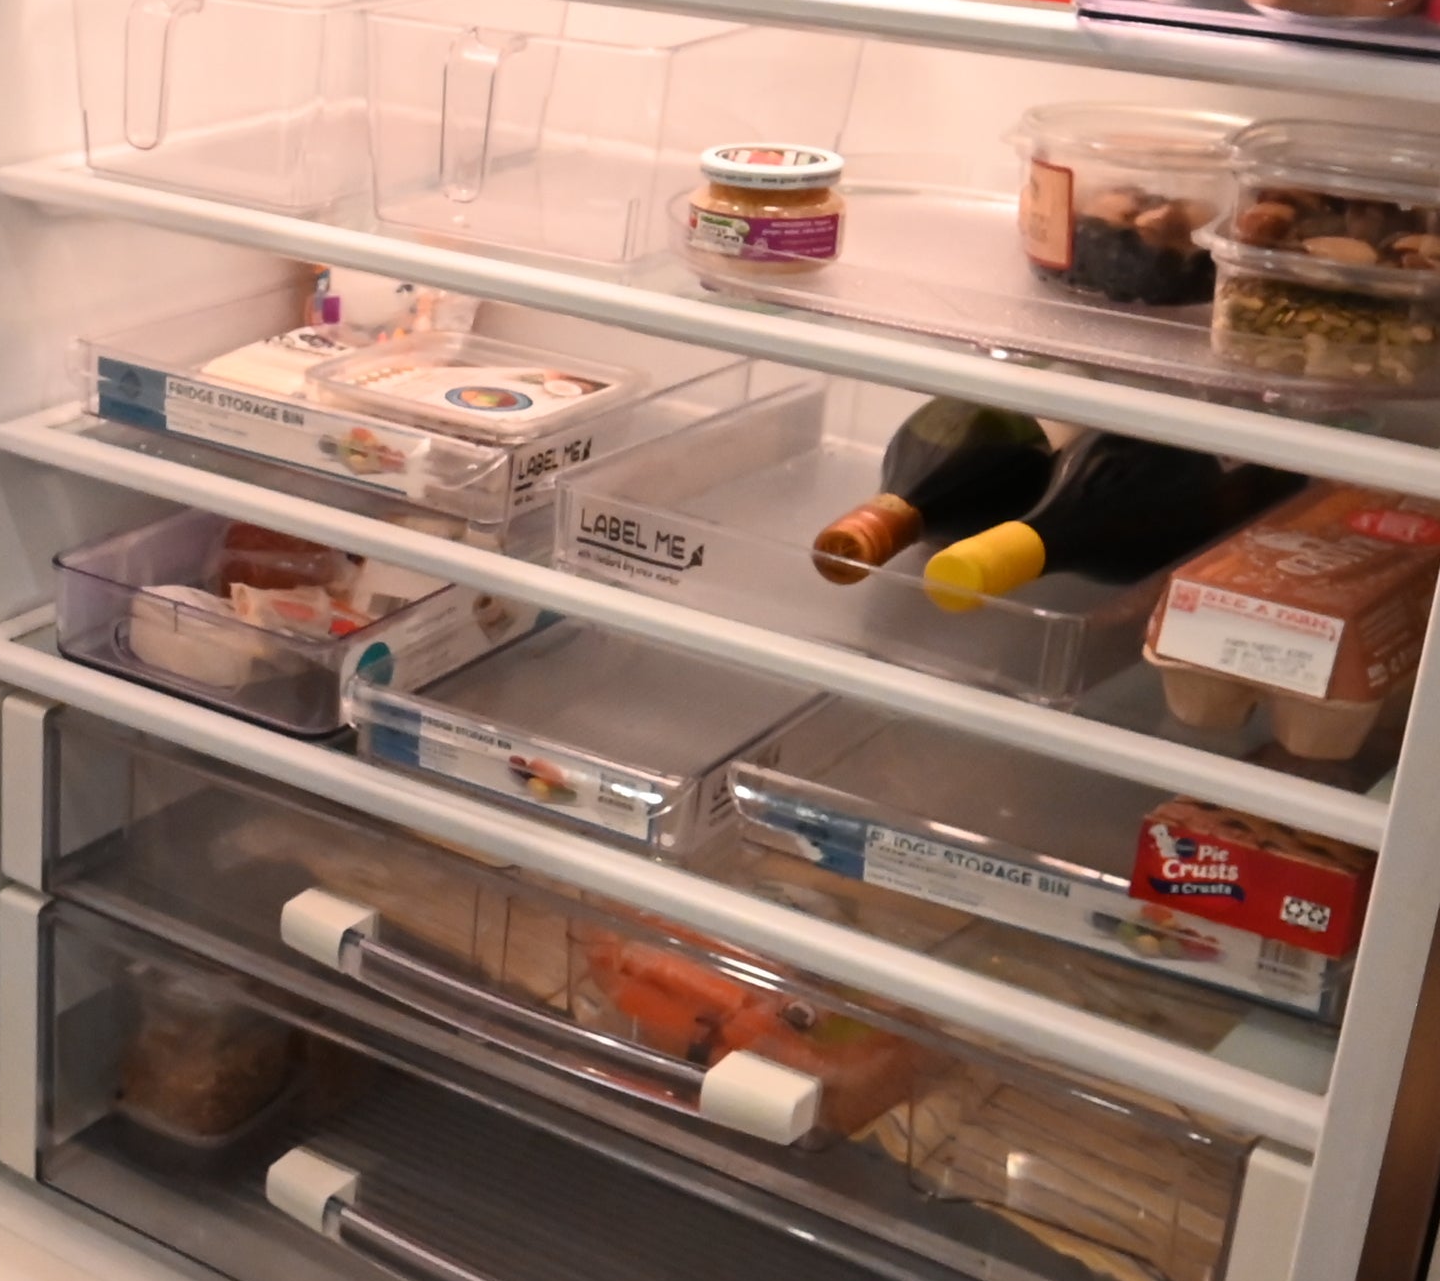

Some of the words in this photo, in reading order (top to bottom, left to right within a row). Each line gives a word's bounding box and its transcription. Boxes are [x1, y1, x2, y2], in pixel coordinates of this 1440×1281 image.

[168, 379, 214, 406] FRIDGE
[219, 393, 279, 421] STORAGE
[282, 407, 304, 427] BIN
[517, 447, 561, 480] LABEL
[580, 507, 647, 550] LABEL
[654, 530, 686, 560] ME
[870, 830, 937, 857] FIDGE
[942, 849, 1033, 886] STORAGE
[1037, 876, 1071, 898] BIN
[1163, 859, 1239, 881] Crusts
[1198, 845, 1229, 862] Pie
[1181, 882, 1233, 895] Crusts
